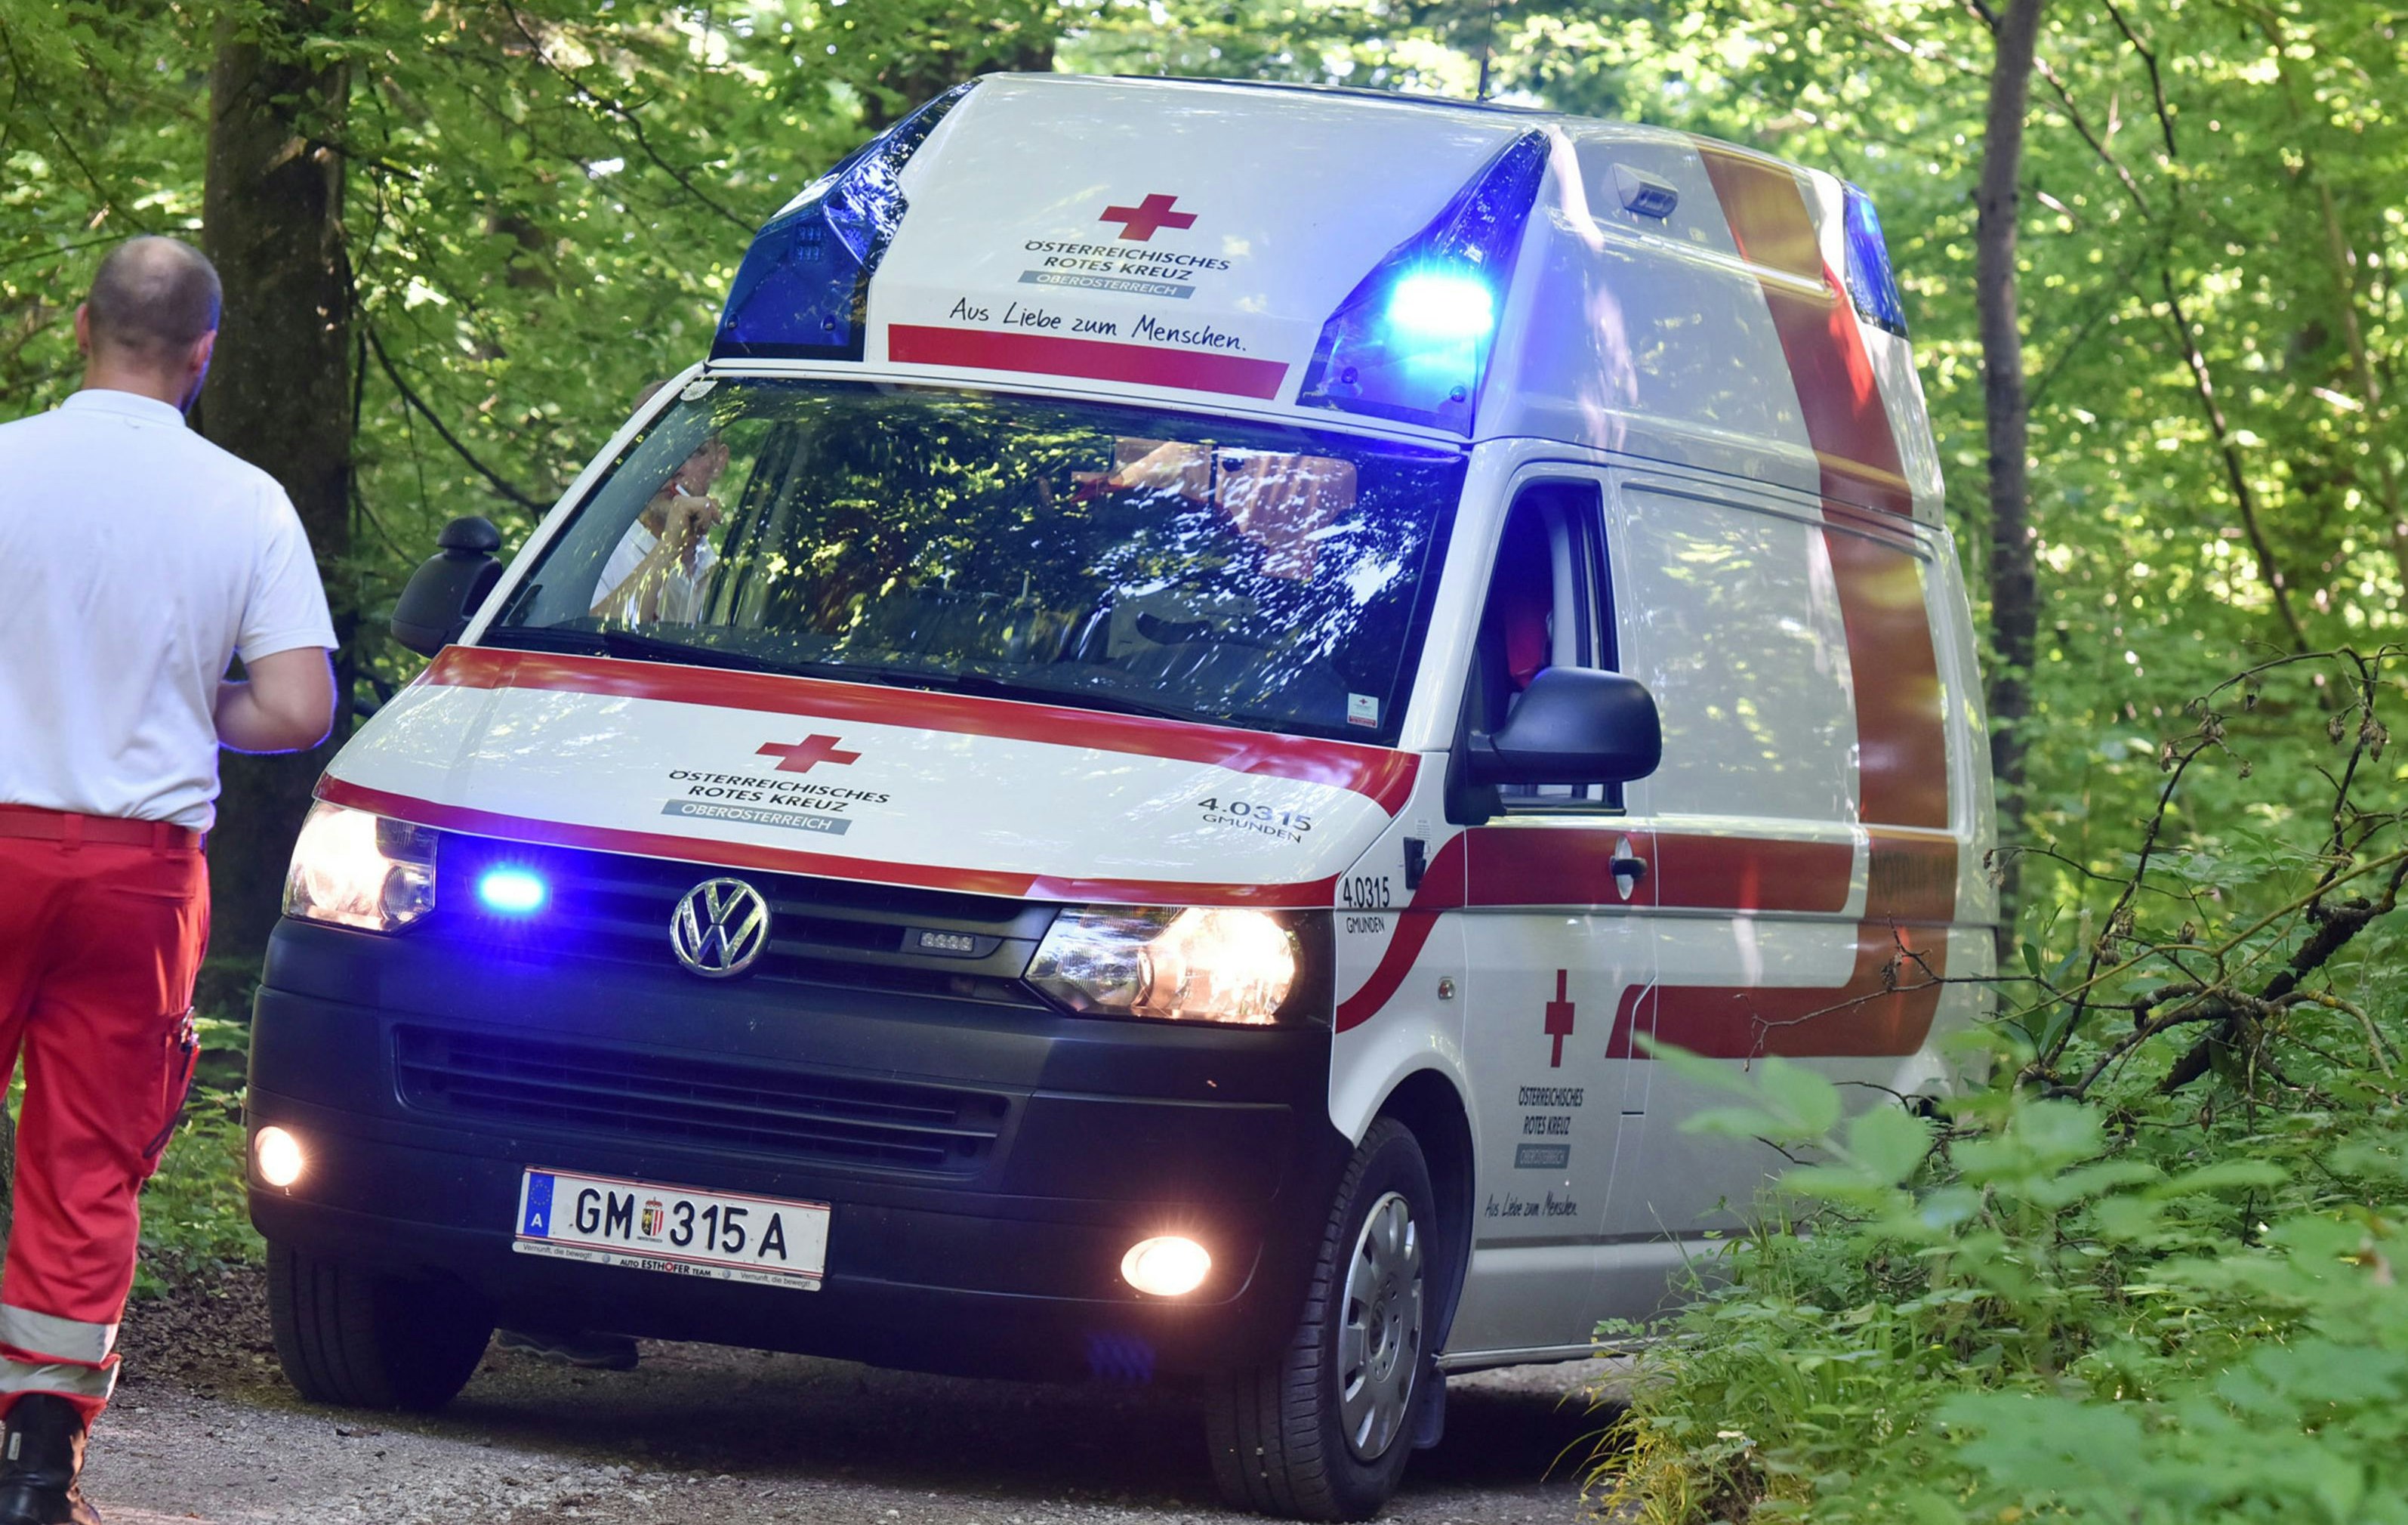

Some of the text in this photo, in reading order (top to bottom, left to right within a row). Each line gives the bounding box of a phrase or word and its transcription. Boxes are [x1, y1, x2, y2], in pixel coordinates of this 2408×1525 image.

[1024, 239, 1232, 270] ÖSTERREICHISCHES
[1043, 256, 1194, 281] ROTES KREUZ
[1035, 273, 1178, 296] OBERÖSTERREICH
[949, 297, 1248, 351] Aus Liebe zum Menschen.
[668, 770, 891, 804] ÖSTERREICHISCHES
[688, 785, 849, 813] ROTES KREUZ
[680, 804, 834, 832] OBERÖSTERREICH
[1198, 797, 1312, 832] 4.0315
[1202, 813, 1302, 844] GMUNDEN
[1343, 876, 1391, 909] 4.0315
[1346, 917, 1386, 934] GMUNDEN
[1518, 1085, 1584, 1107] ÖSTERREICHISCHES
[1522, 1116, 1571, 1135] ROTES KREUZ
[1485, 1193, 1500, 1218] Aus
[530, 1214, 544, 1229] A
[575, 1188, 788, 1261] GM 315 A
[619, 1258, 712, 1277] AUTO ESTHOFER TEAM
[771, 1275, 783, 1283] die
